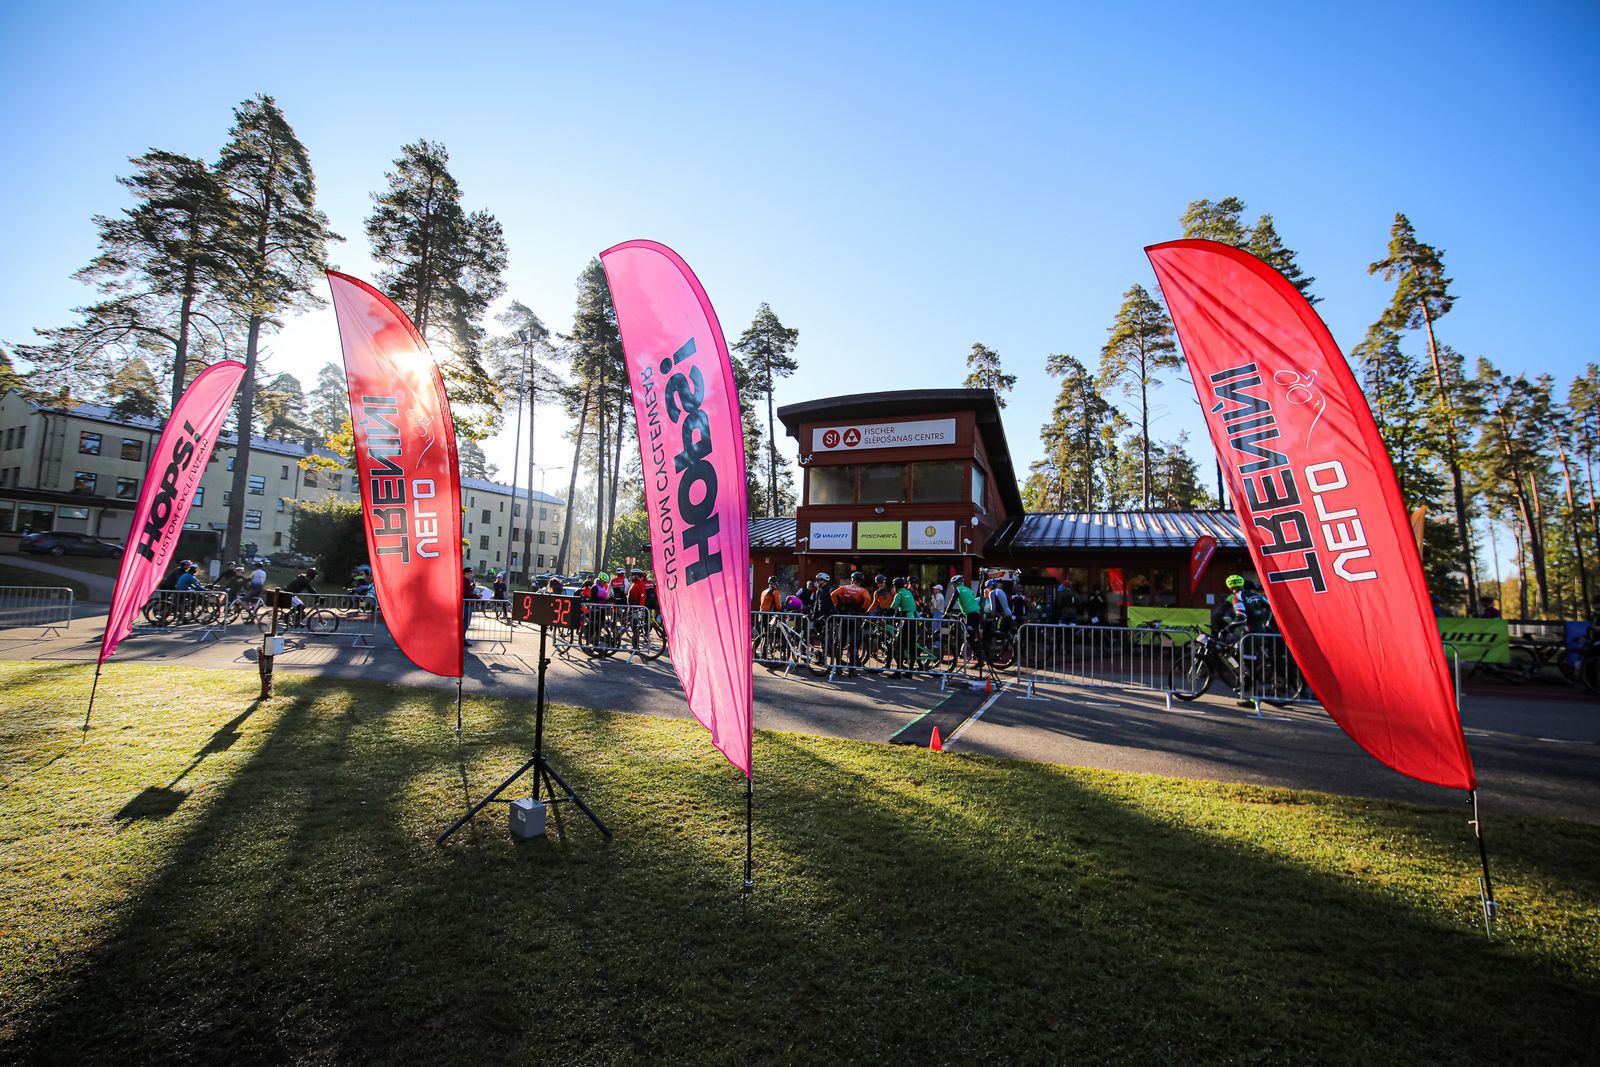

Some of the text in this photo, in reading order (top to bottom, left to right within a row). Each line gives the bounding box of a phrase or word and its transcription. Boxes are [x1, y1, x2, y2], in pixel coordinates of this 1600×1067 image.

[864, 427, 895, 436] FISCHER
[914, 433, 945, 442] CENTRS
[139, 420, 201, 562] HOPS!
[156, 438, 209, 567] CUSTOM CYCLEWEAR
[1441, 631, 1498, 643] UHTI
